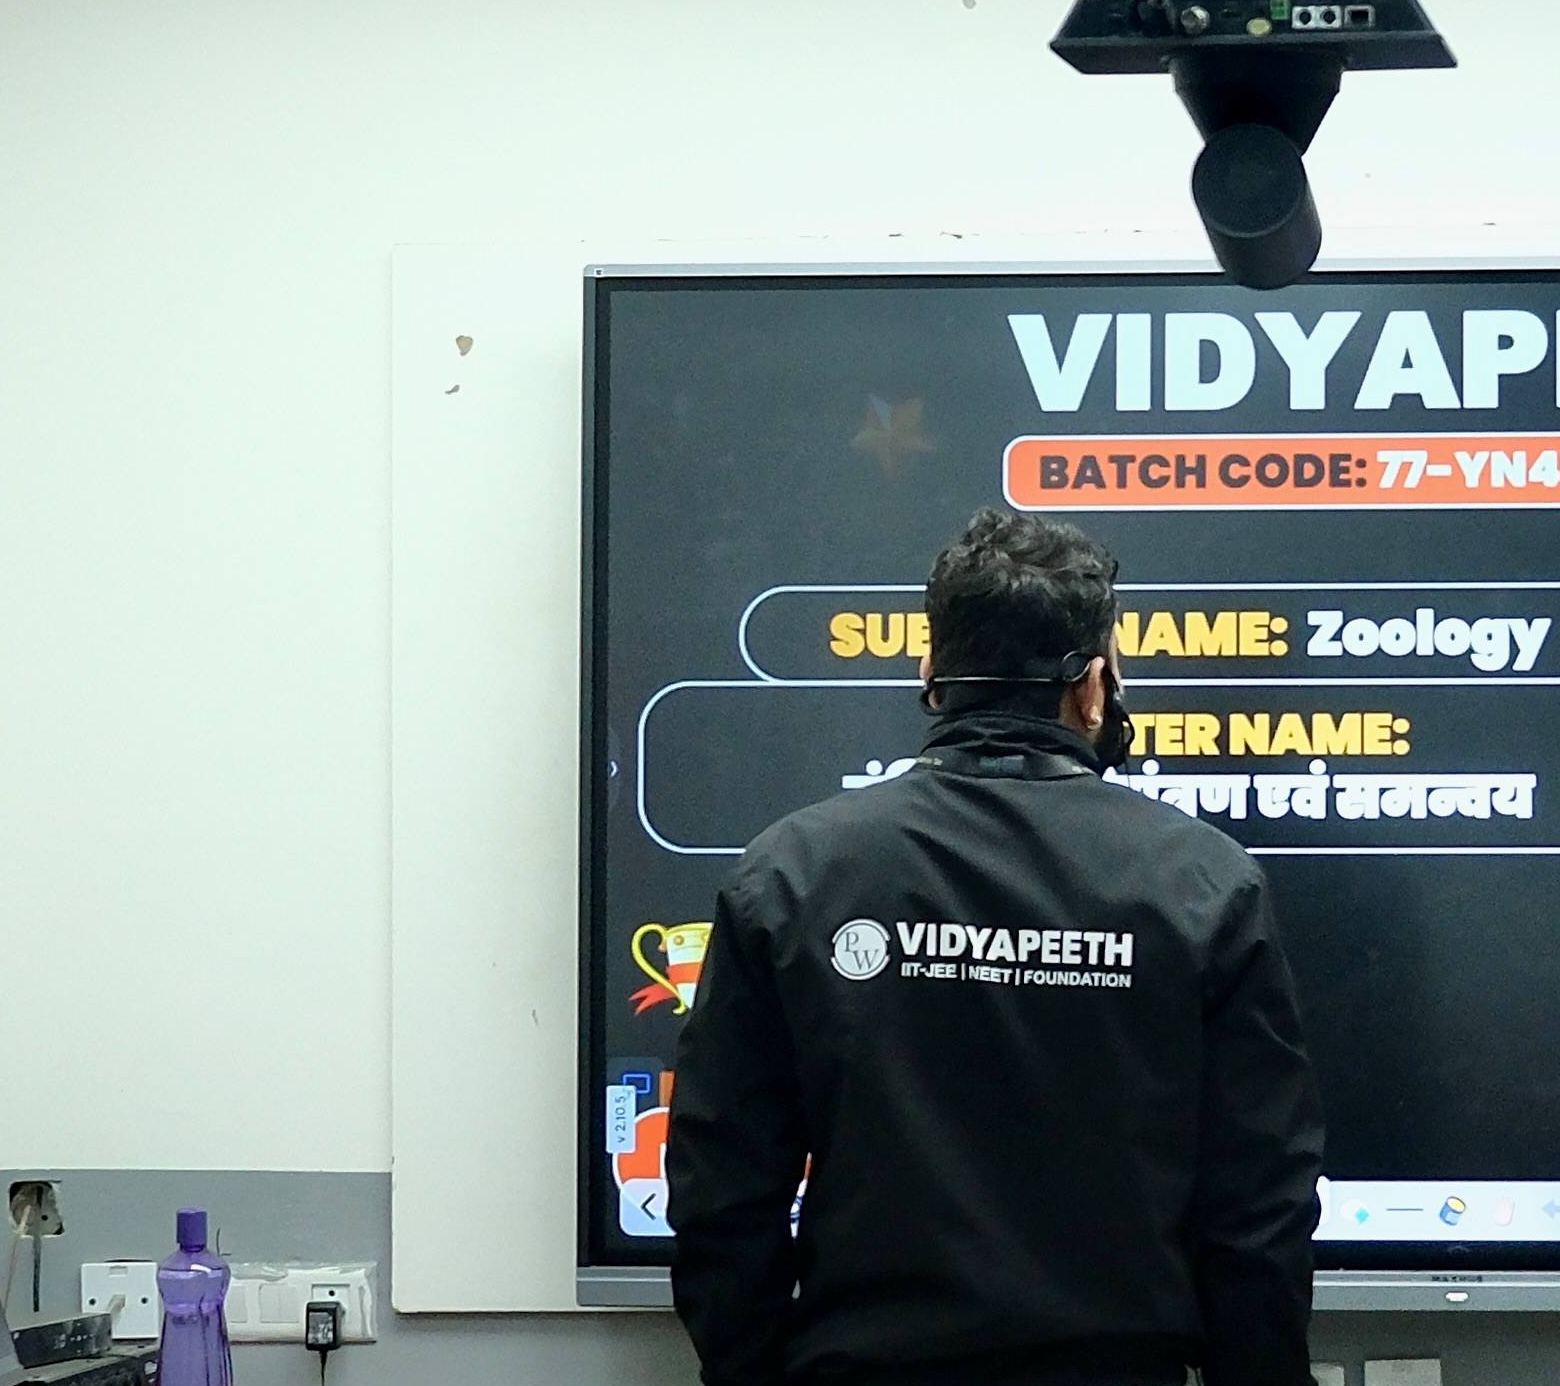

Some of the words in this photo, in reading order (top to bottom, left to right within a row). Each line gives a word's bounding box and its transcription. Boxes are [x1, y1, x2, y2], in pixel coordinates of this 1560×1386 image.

[1040, 454, 1207, 489] BATCH
[1220, 453, 1367, 488] CODE:
[1115, 611, 1289, 657] NAME:
[1306, 610, 1552, 671] Zoology
[1229, 713, 1411, 756] NAME:
[1253, 759, 1332, 820] एवं
[1333, 773, 1538, 821] समन्वय
[896, 921, 1134, 967] VIDYAPEETH
[901, 961, 958, 978] IIT-JEE
[968, 965, 1013, 984] NEET
[1023, 969, 1133, 989] FOUNDATION
